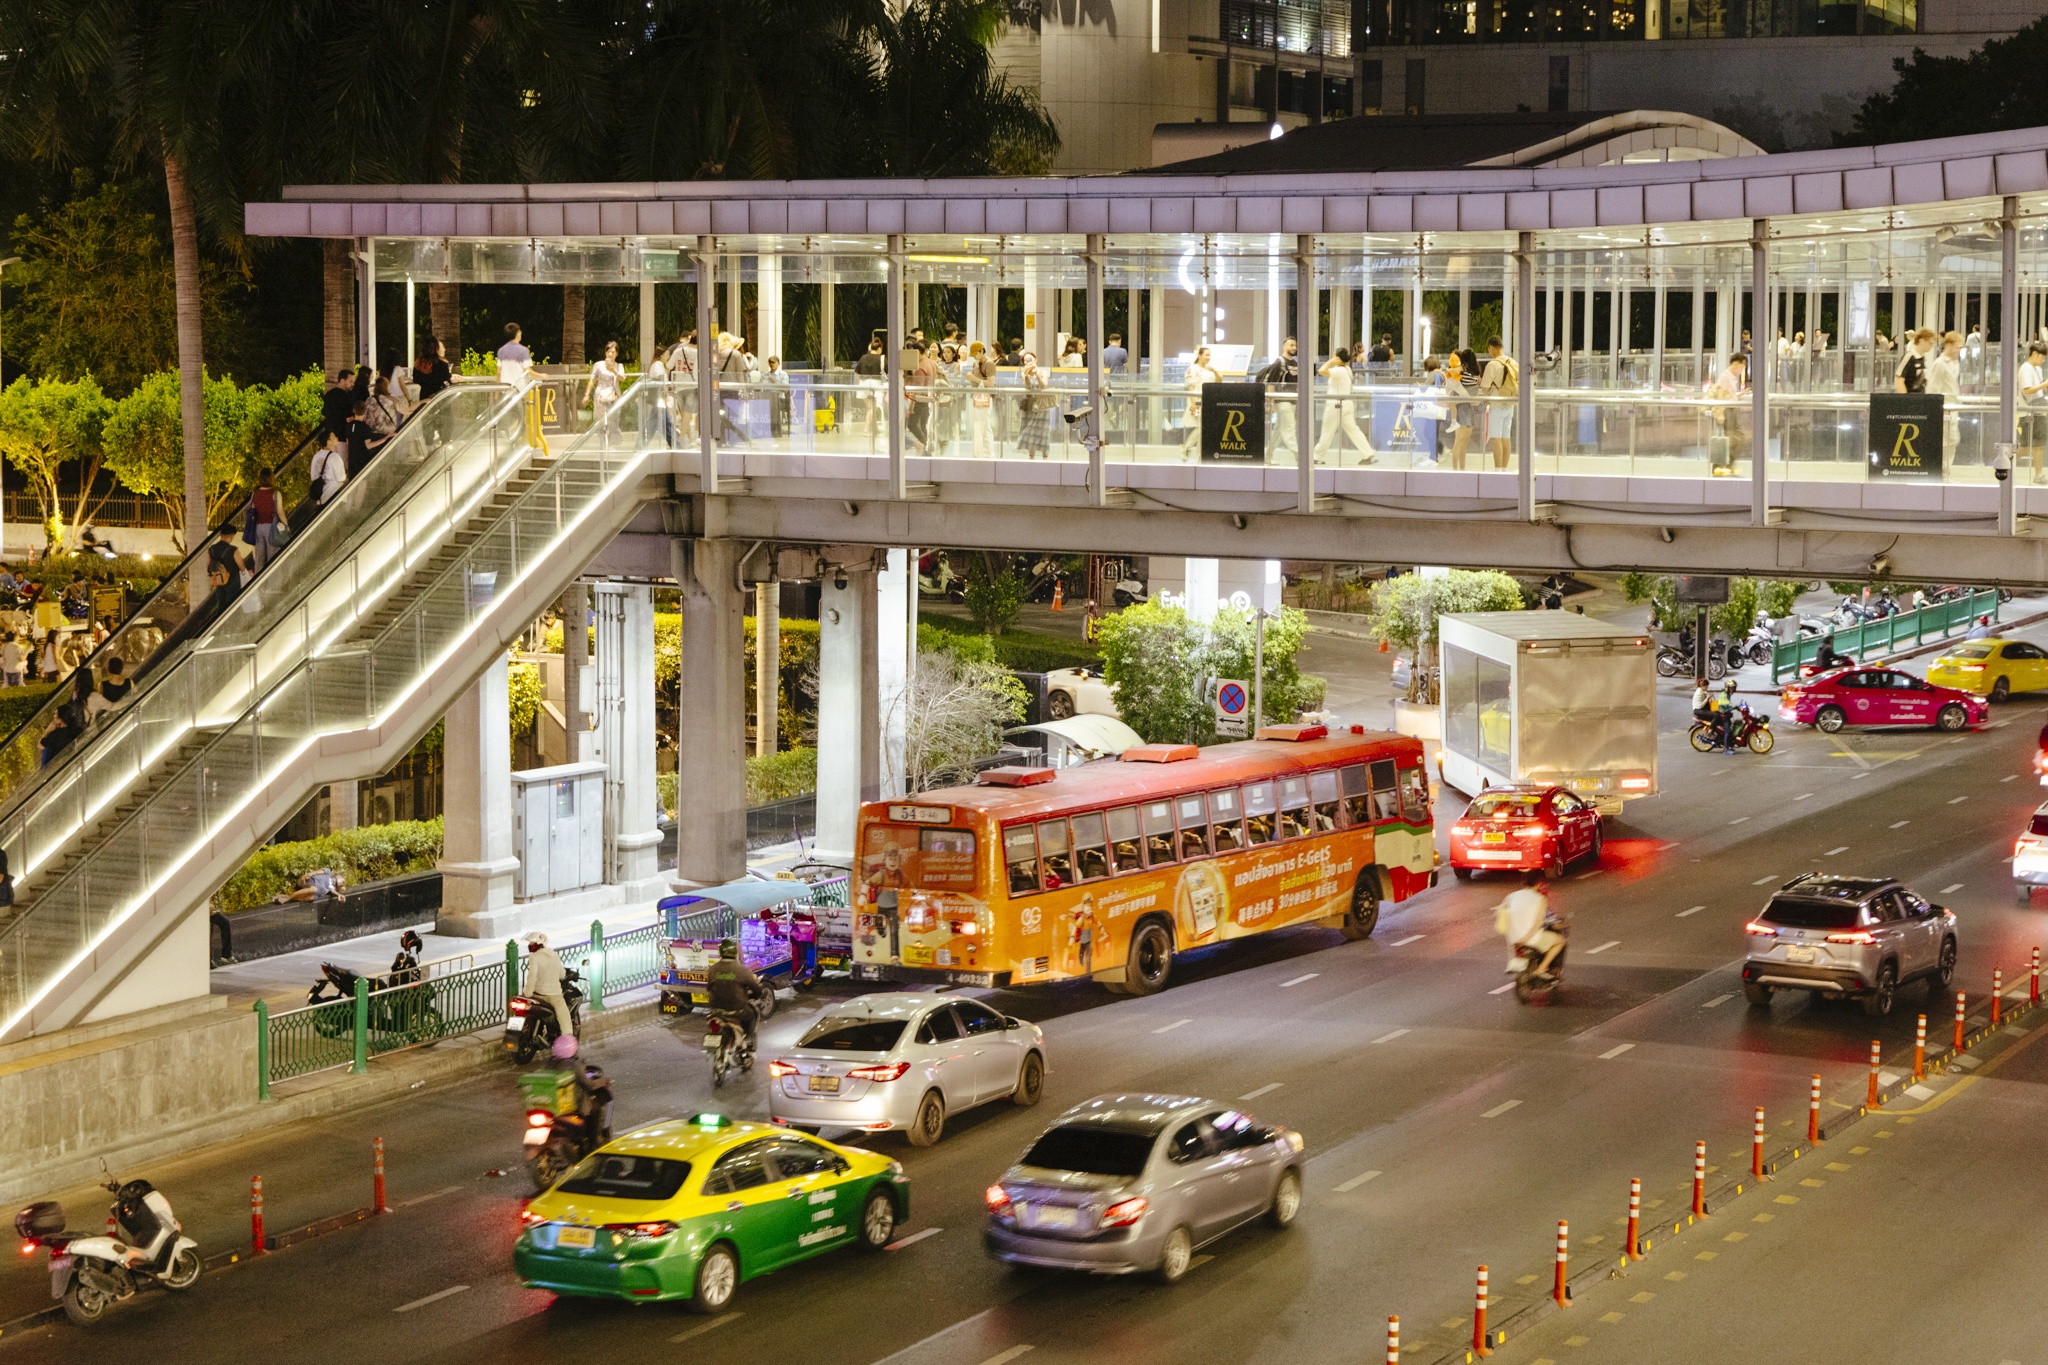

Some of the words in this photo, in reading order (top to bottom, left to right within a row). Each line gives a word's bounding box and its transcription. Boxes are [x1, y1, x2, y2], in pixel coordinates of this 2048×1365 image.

[544, 388, 557, 415] R
[543, 415, 558, 423] WALK
[1222, 410, 1245, 441] R
[1220, 442, 1247, 451] WALK
[1892, 423, 1919, 457] R
[1890, 457, 1921, 467] WALK
[901, 807, 917, 820] 54
[1297, 845, 1331, 869] E-GetS
